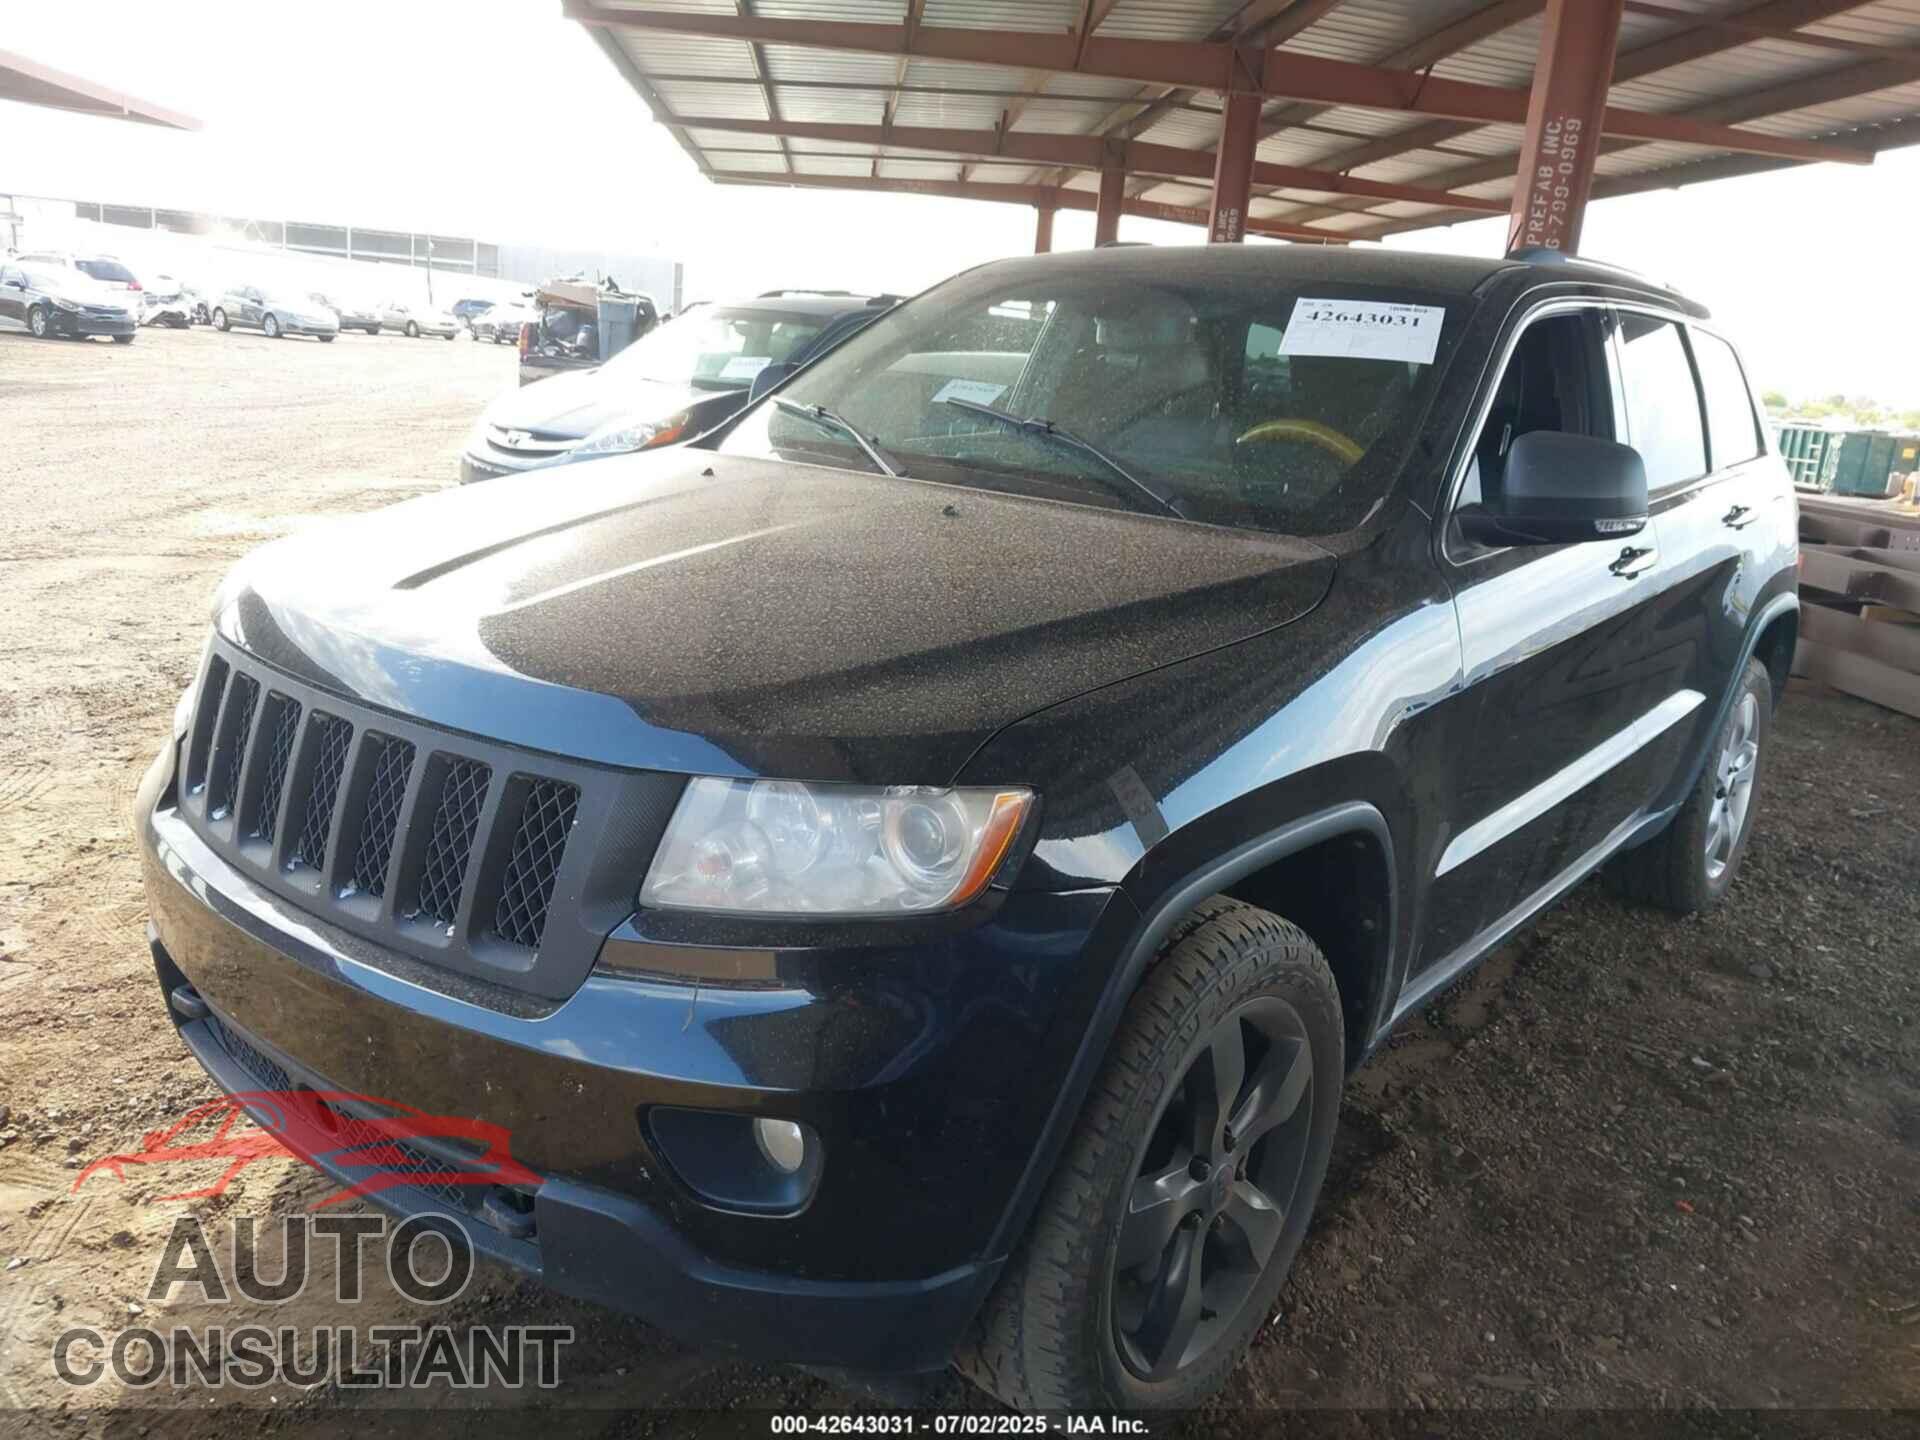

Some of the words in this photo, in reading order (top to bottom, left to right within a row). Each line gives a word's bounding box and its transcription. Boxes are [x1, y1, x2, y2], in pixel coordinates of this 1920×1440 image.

[1526, 165, 1554, 246] PREFAB
[1543, 115, 1565, 155] INC.
[1305, 310, 1421, 328] 42643031
